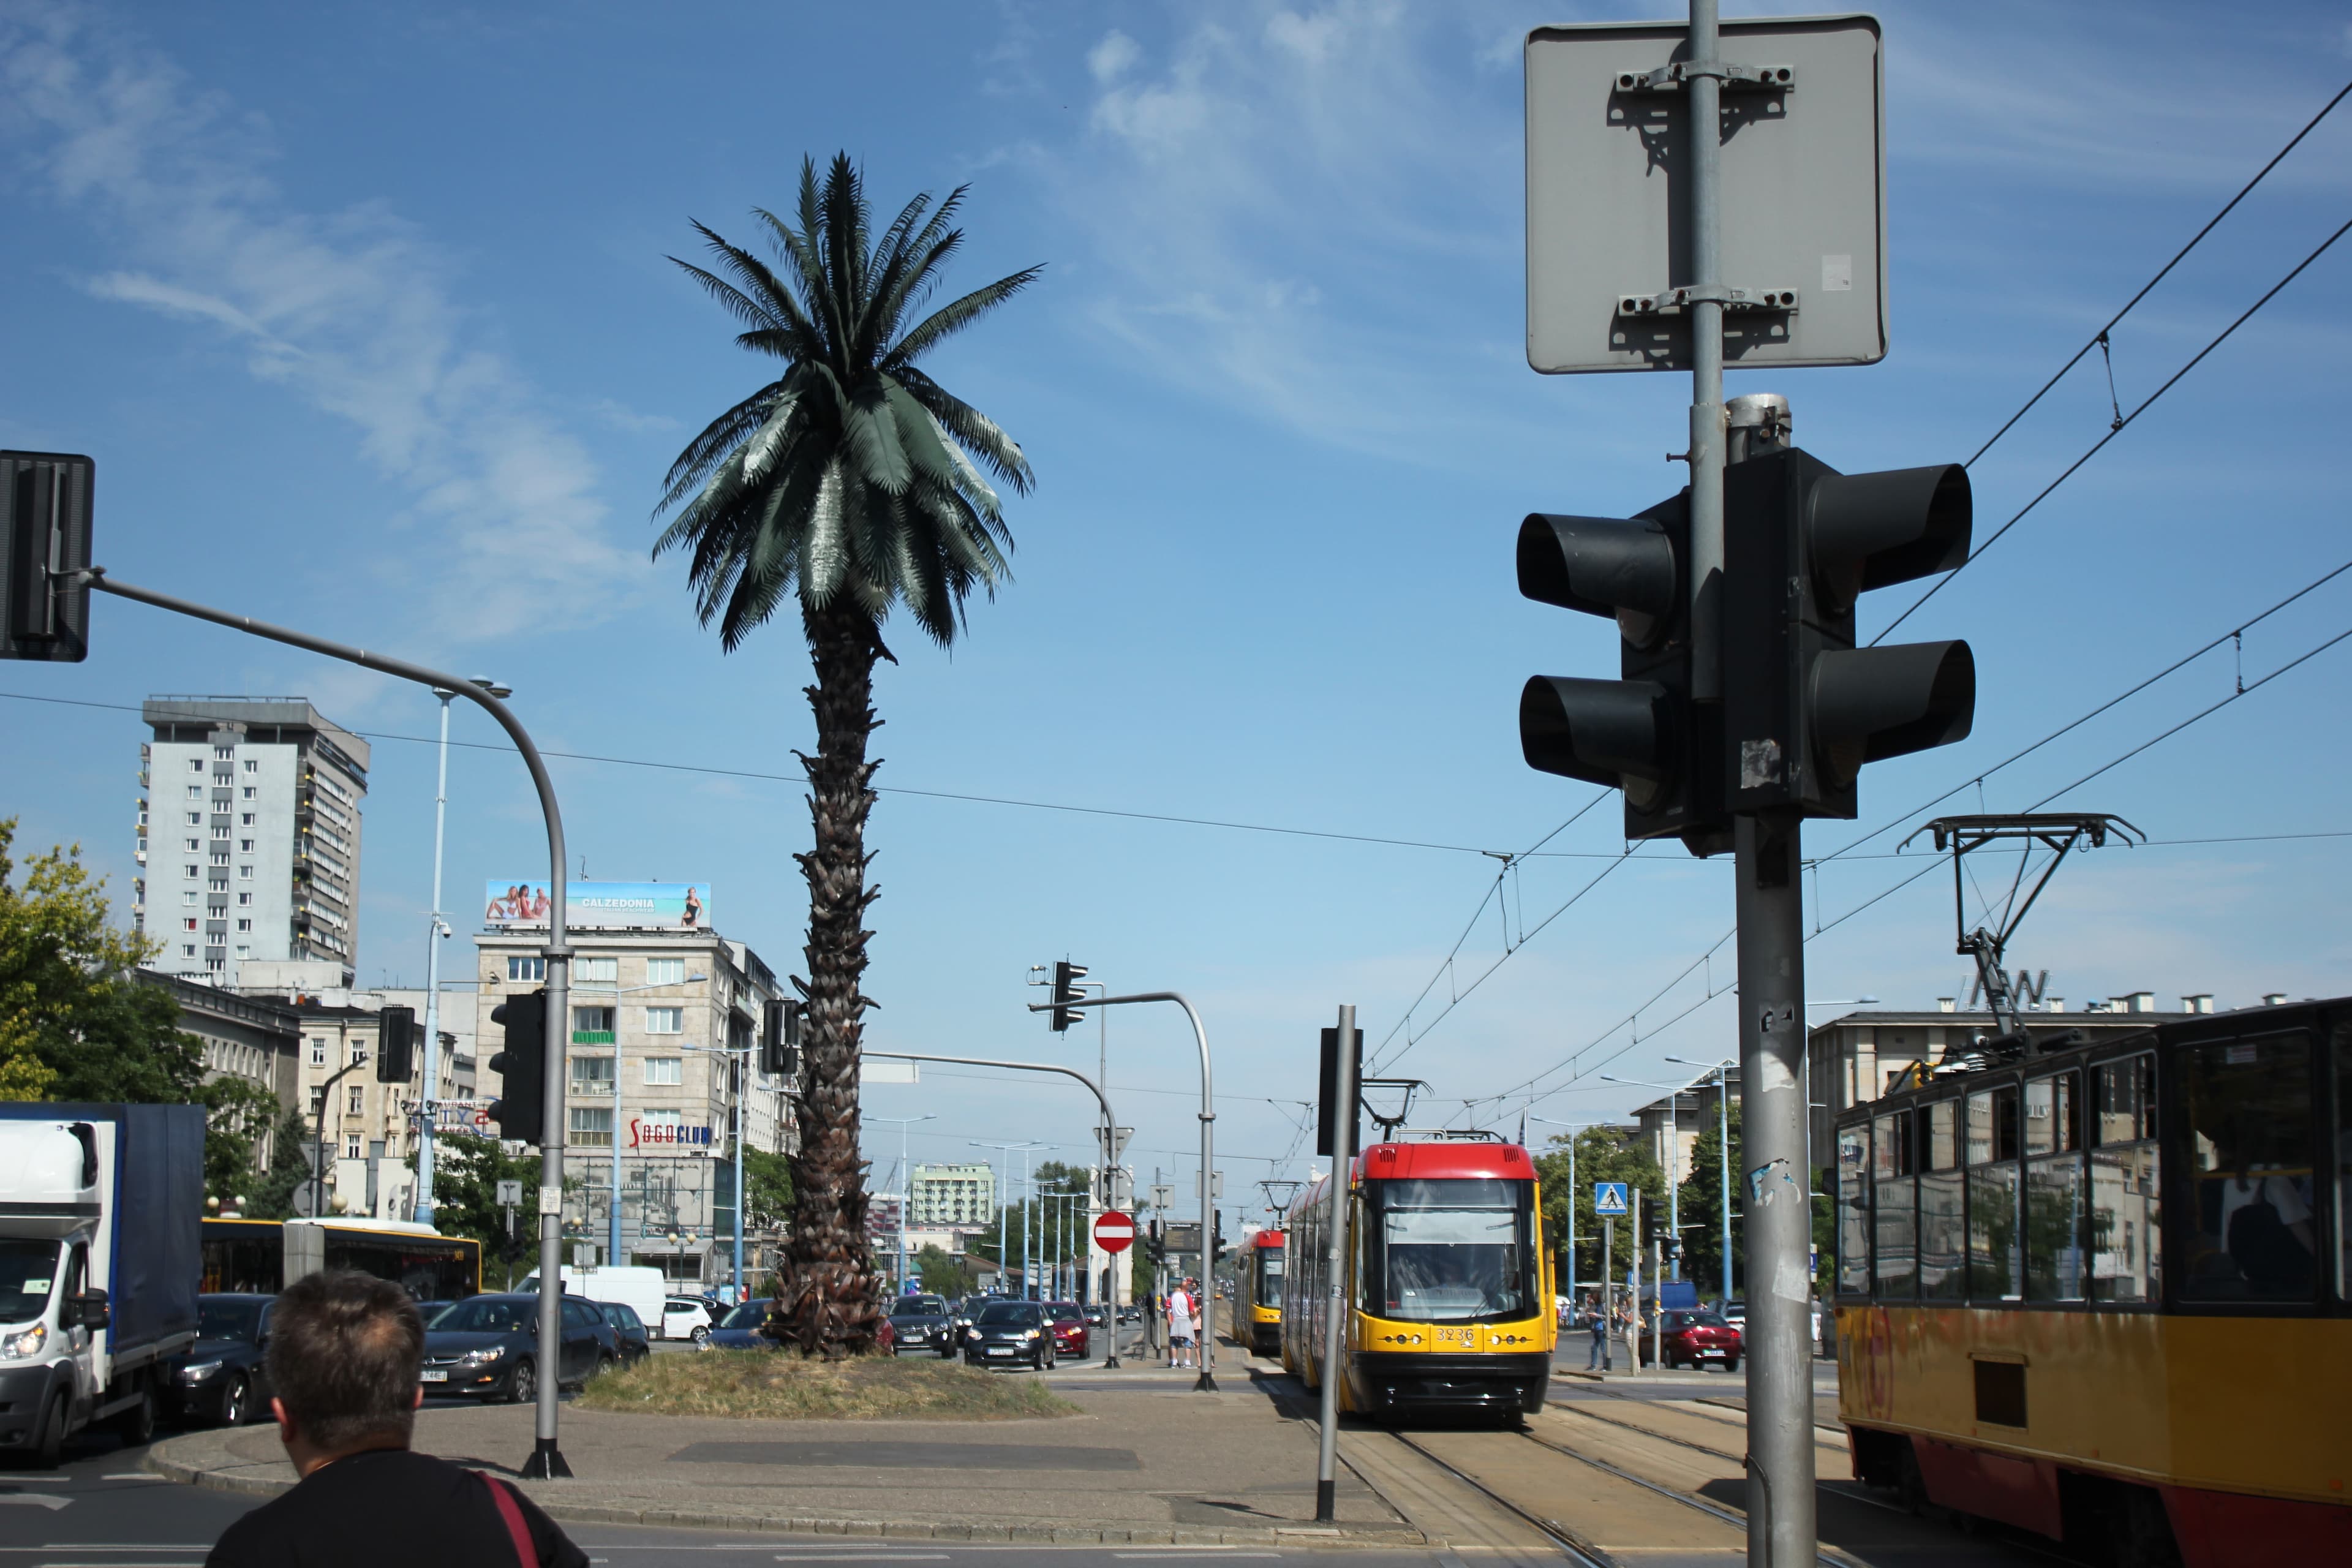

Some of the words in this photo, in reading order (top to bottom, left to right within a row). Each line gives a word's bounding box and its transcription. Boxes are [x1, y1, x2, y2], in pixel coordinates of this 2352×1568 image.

[582, 899, 654, 908] CALZEDONIA
[629, 1118, 673, 1148] SOGO
[677, 1125, 709, 1144] CLUB
